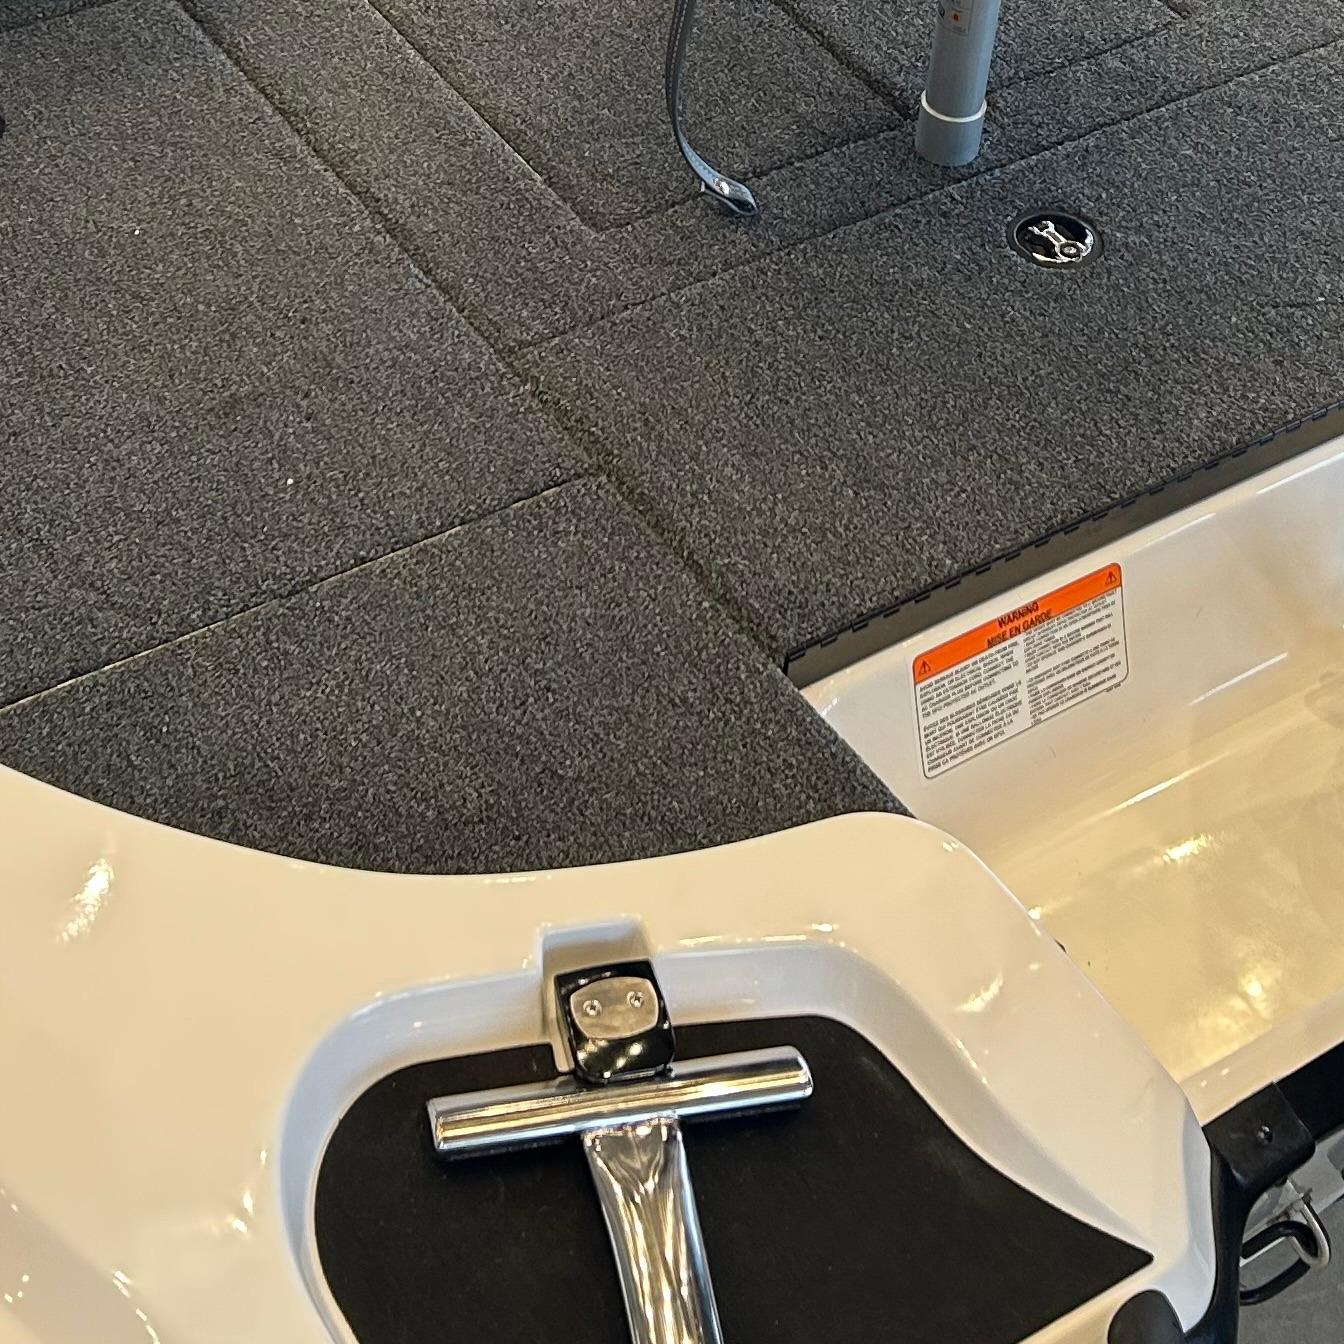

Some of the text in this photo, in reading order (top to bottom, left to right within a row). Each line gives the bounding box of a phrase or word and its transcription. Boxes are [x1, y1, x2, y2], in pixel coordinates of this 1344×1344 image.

[986, 609, 1053, 649] MISE EN GARDE
[997, 600, 1040, 629] WARNING
